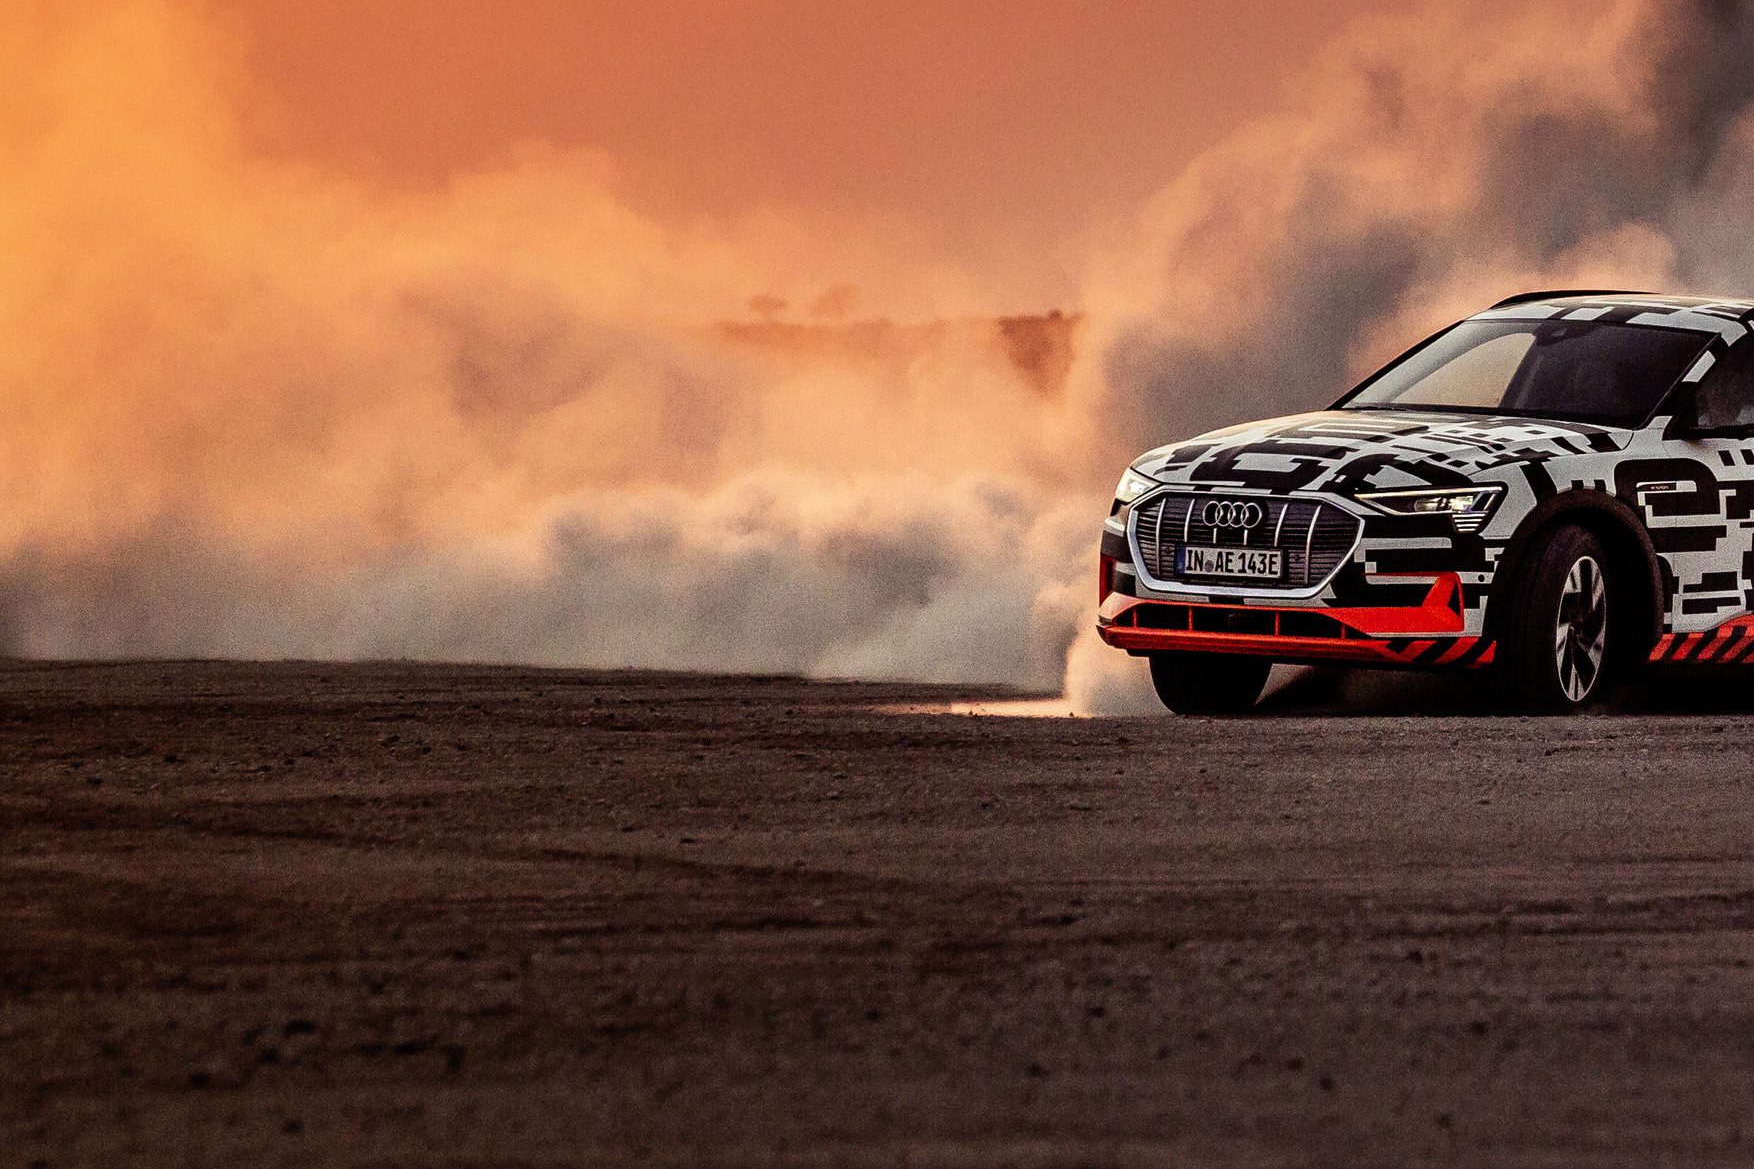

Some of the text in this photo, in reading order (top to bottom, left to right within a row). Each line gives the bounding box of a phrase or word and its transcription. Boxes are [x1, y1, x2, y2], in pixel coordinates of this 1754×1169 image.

[1186, 550, 1204, 571] IN
[1214, 551, 1234, 573] AE
[1238, 552, 1278, 575] 143E
